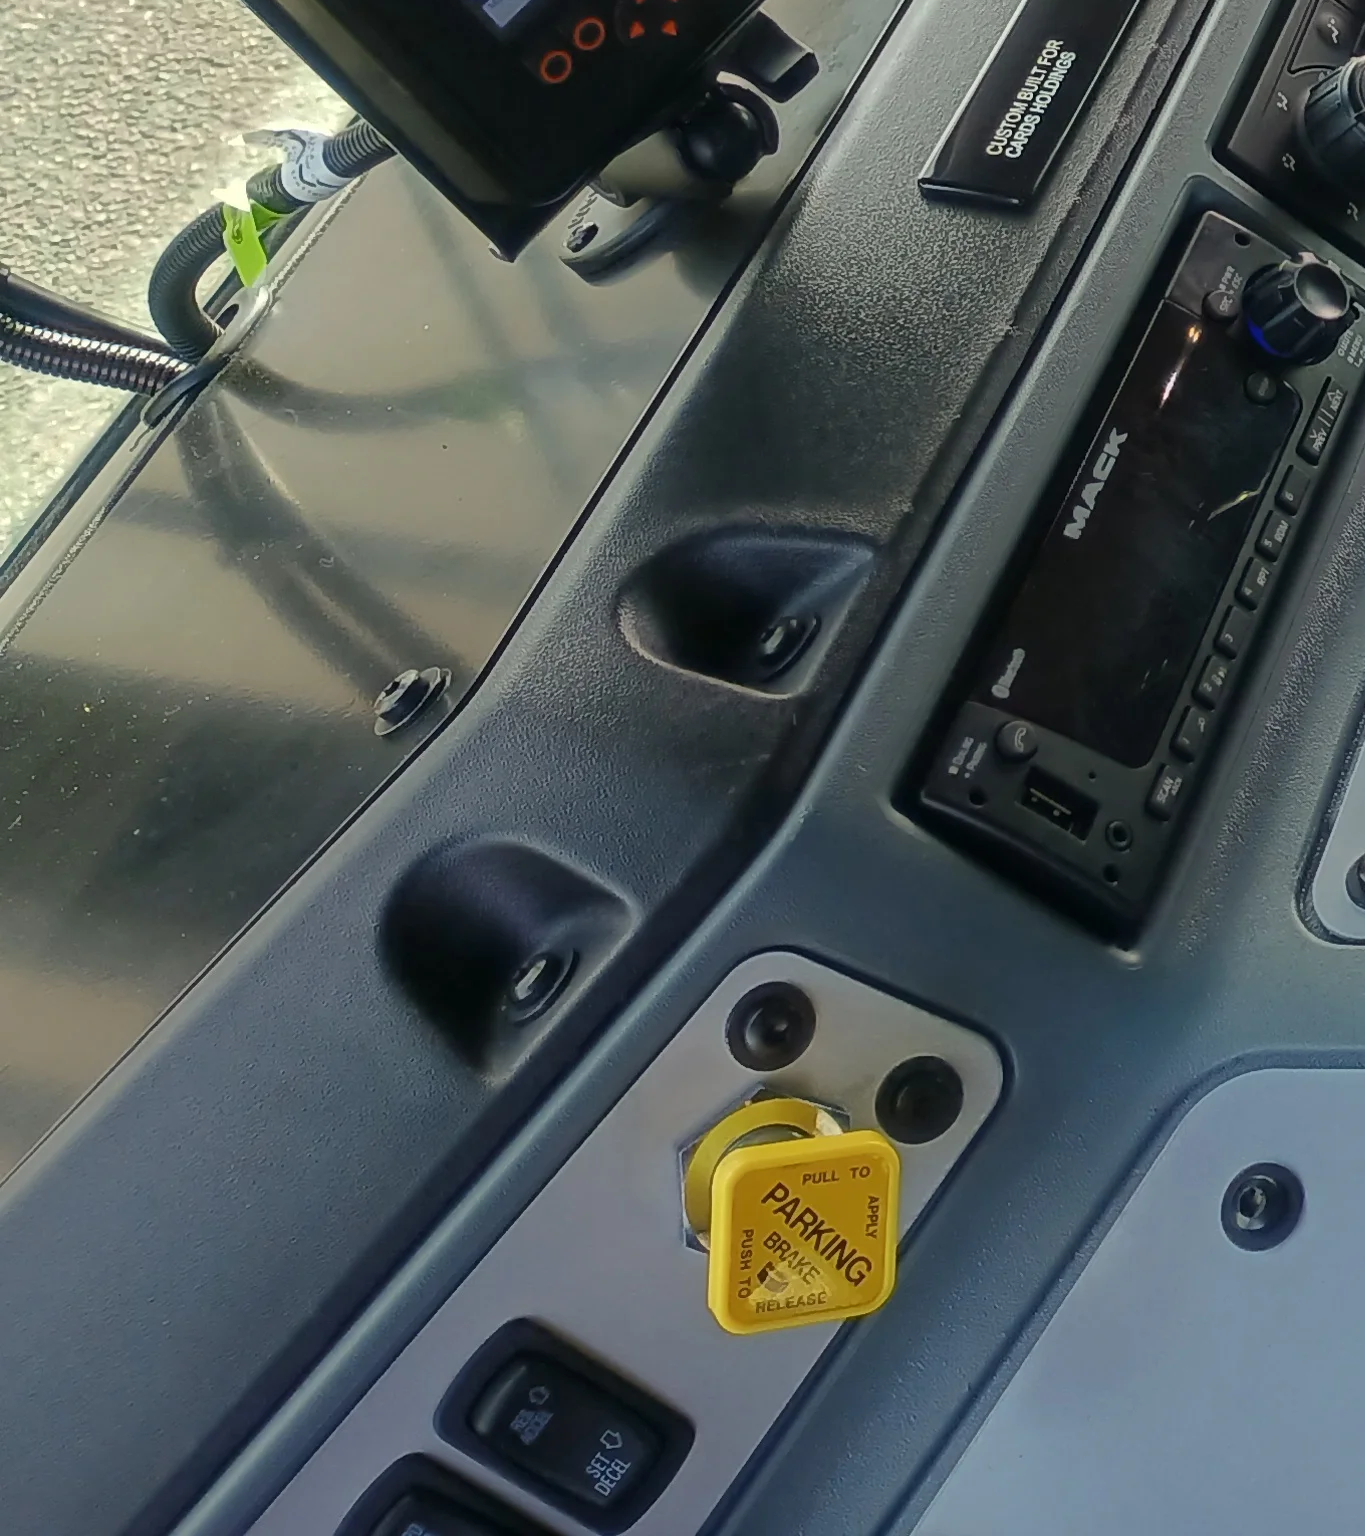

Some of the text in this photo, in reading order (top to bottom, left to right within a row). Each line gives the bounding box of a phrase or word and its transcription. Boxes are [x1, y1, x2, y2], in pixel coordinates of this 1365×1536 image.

[985, 39, 1065, 156] CUSTOM BUILT FOR
[1005, 51, 1077, 159] CARDS HOLDINGS
[1330, 389, 1344, 413] NEXT
[1312, 430, 1327, 452] PREV
[1062, 427, 1129, 540] MACK
[1156, 776, 1174, 804] SCAN
[801, 1165, 872, 1186] PULL TO
[760, 1181, 874, 1288] PARKING
[864, 1195, 881, 1240] APPLY
[737, 1228, 755, 1300] PUSH TO
[762, 1230, 821, 1286] BRAKE
[755, 1290, 829, 1315] RELEASE
[585, 1451, 611, 1479] SET
[593, 1458, 632, 1497] DECEL
